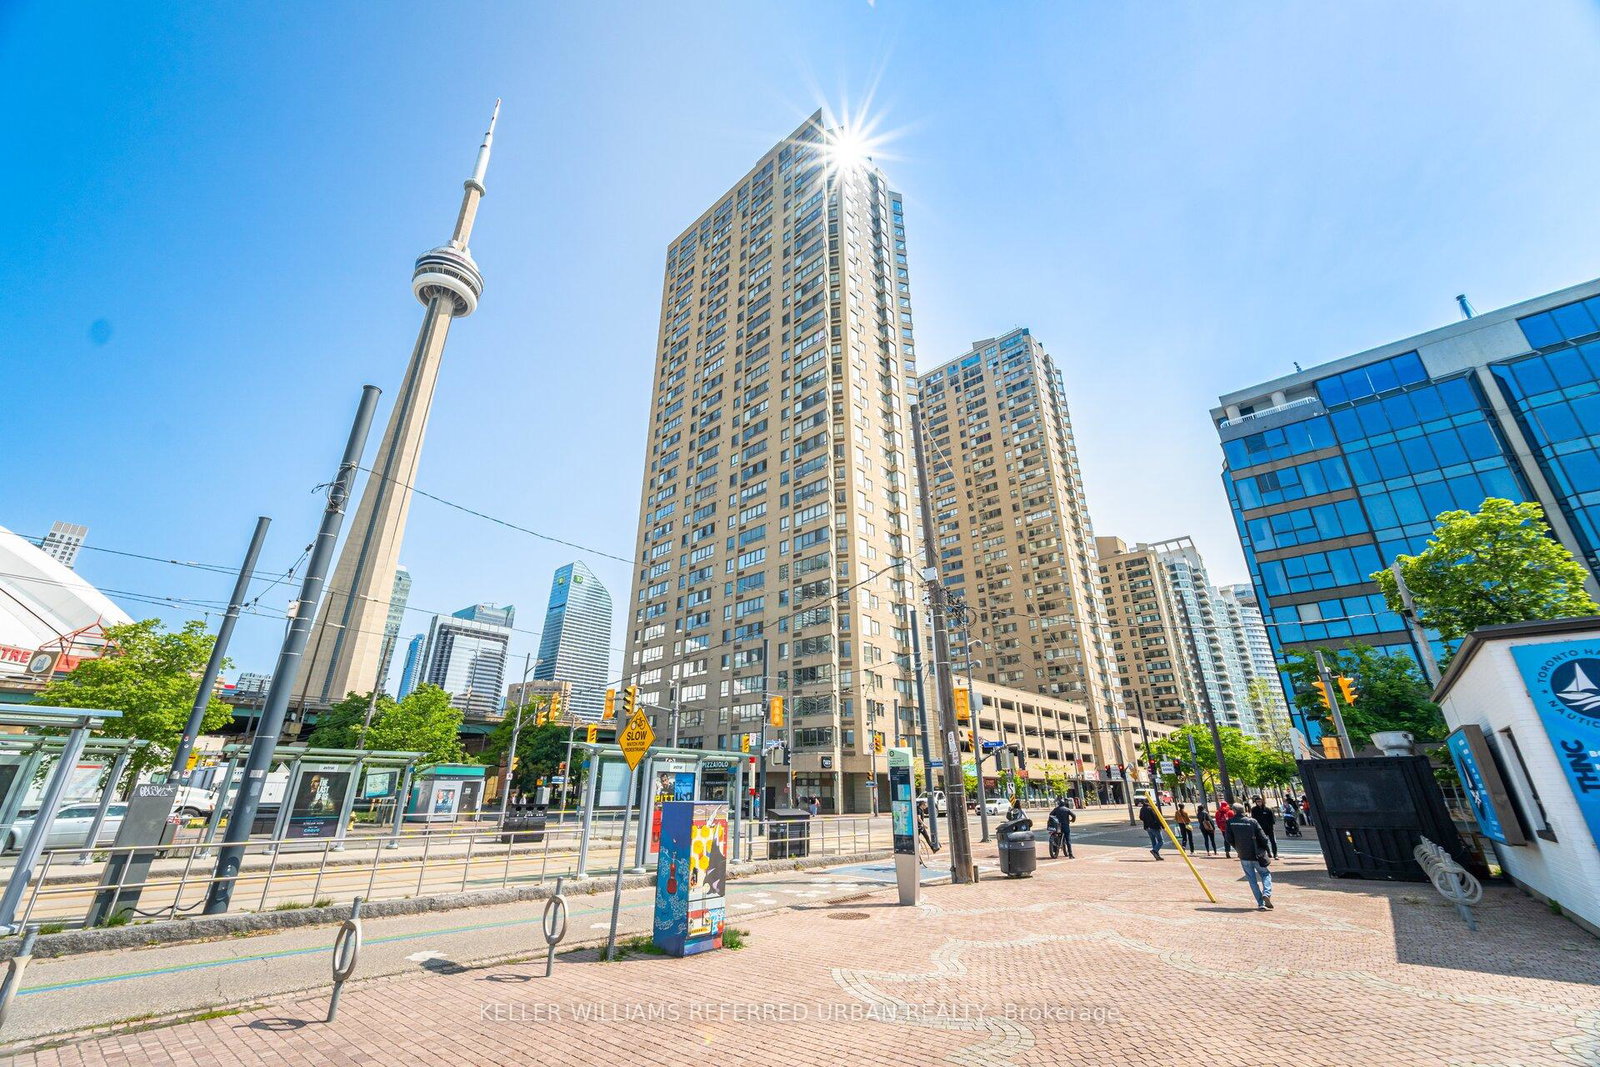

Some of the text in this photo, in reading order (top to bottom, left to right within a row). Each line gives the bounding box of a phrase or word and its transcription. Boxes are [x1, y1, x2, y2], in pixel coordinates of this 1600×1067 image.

[0, 645, 32, 664] TRE
[1537, 650, 1579, 684] TORONTO
[1548, 700, 1600, 728] NAUTIC
[627, 731, 647, 741] SLOW
